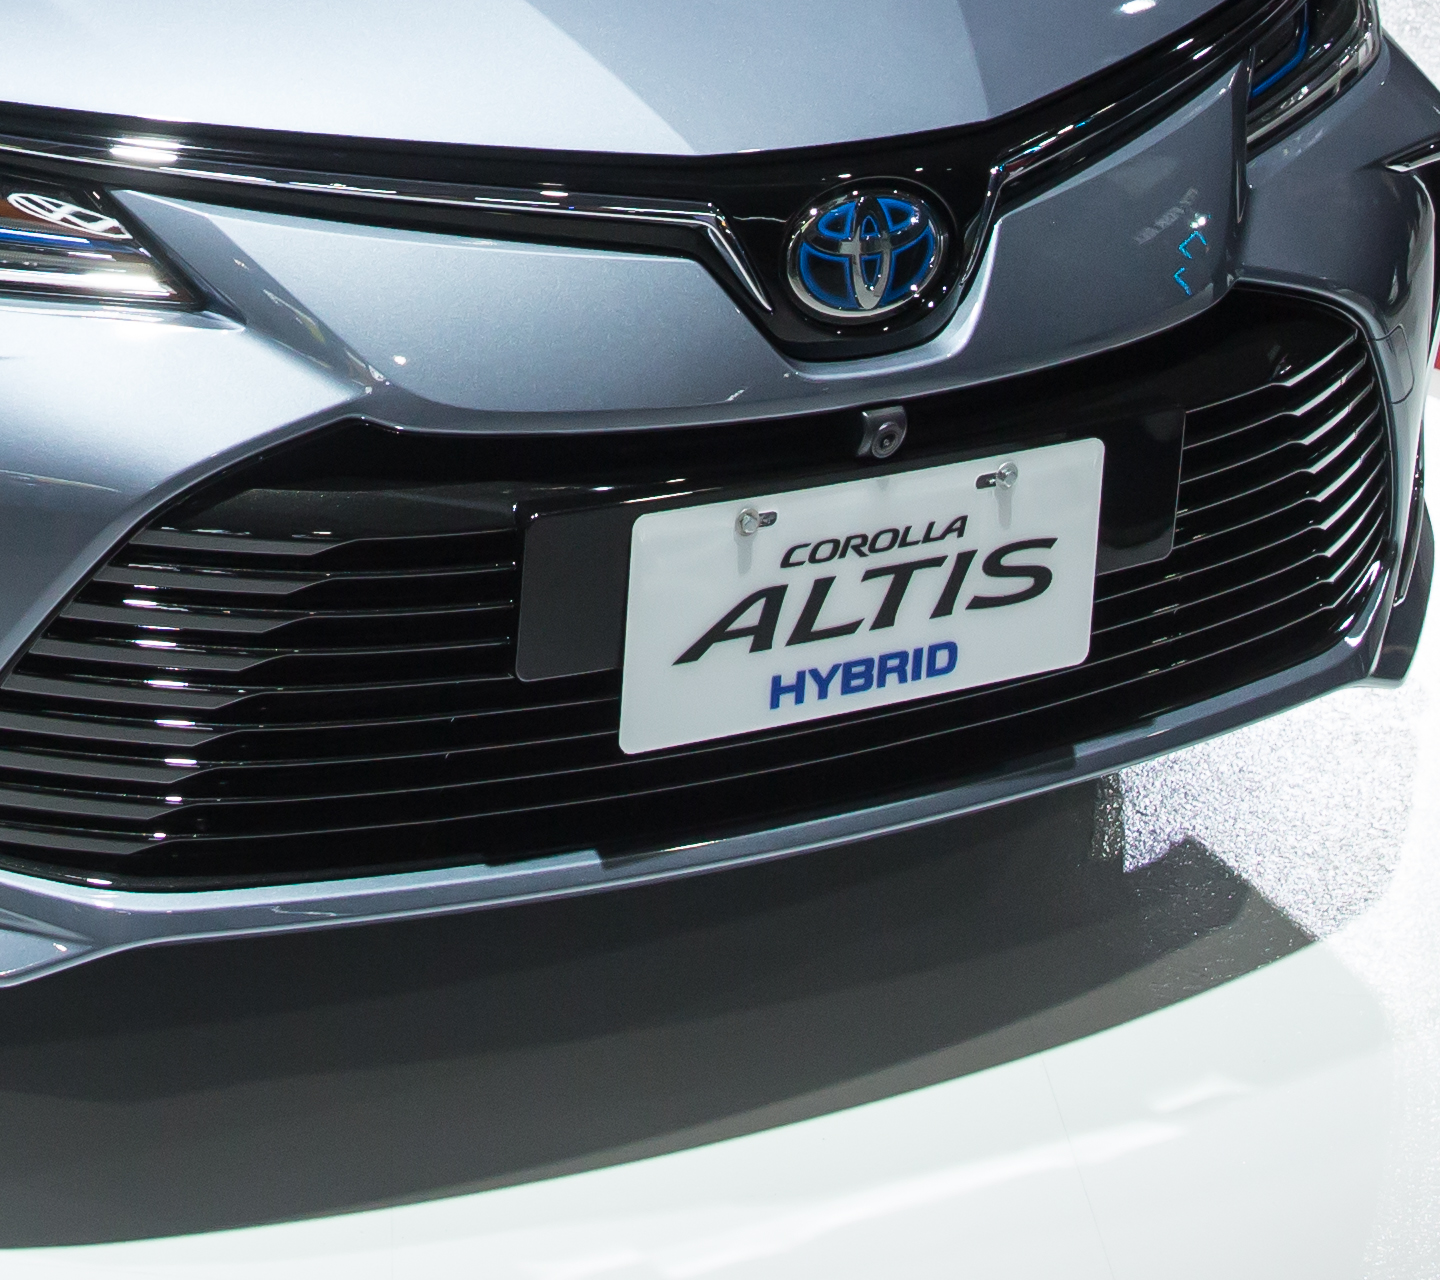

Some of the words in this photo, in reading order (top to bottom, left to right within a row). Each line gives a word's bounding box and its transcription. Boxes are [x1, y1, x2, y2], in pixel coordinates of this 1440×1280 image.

[779, 514, 969, 569] COROLLA
[671, 537, 1058, 667] ALTIS
[769, 640, 959, 710] HYBRID
